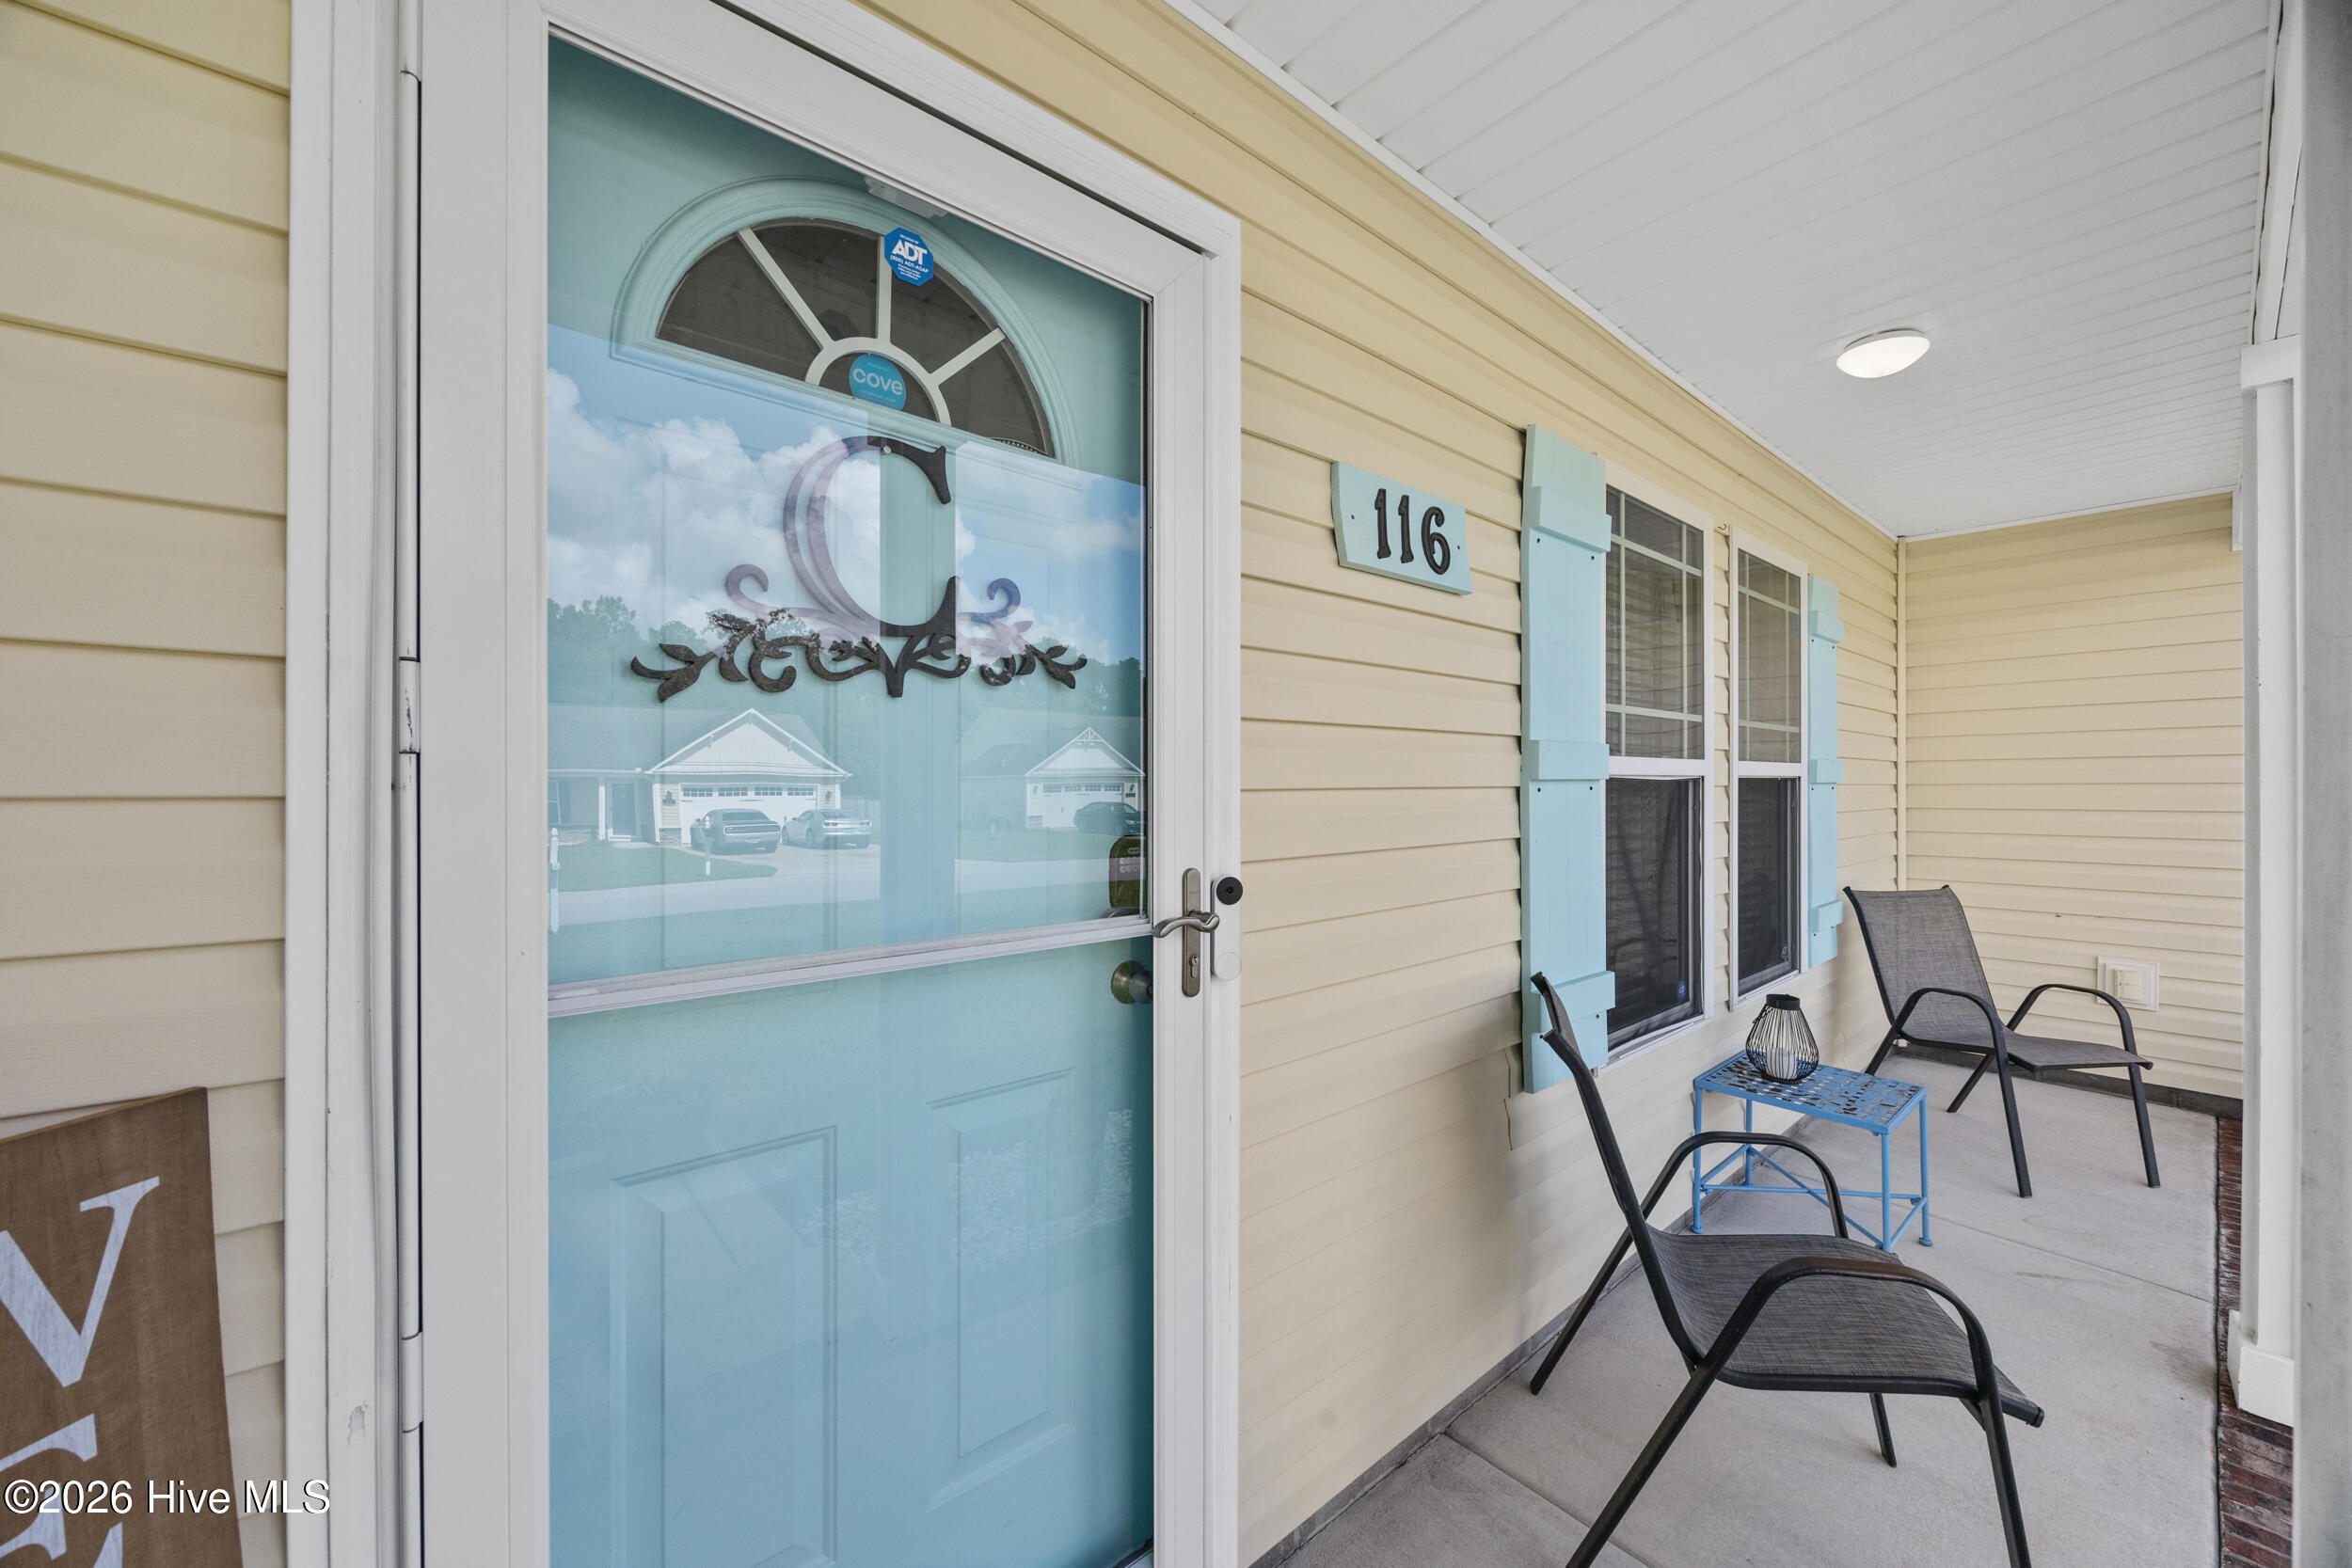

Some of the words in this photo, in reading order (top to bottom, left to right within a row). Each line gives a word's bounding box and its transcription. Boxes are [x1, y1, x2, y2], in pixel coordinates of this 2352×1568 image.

[891, 239, 928, 265] ADT
[852, 368, 903, 395] cove
[1374, 488, 1451, 576] 116
